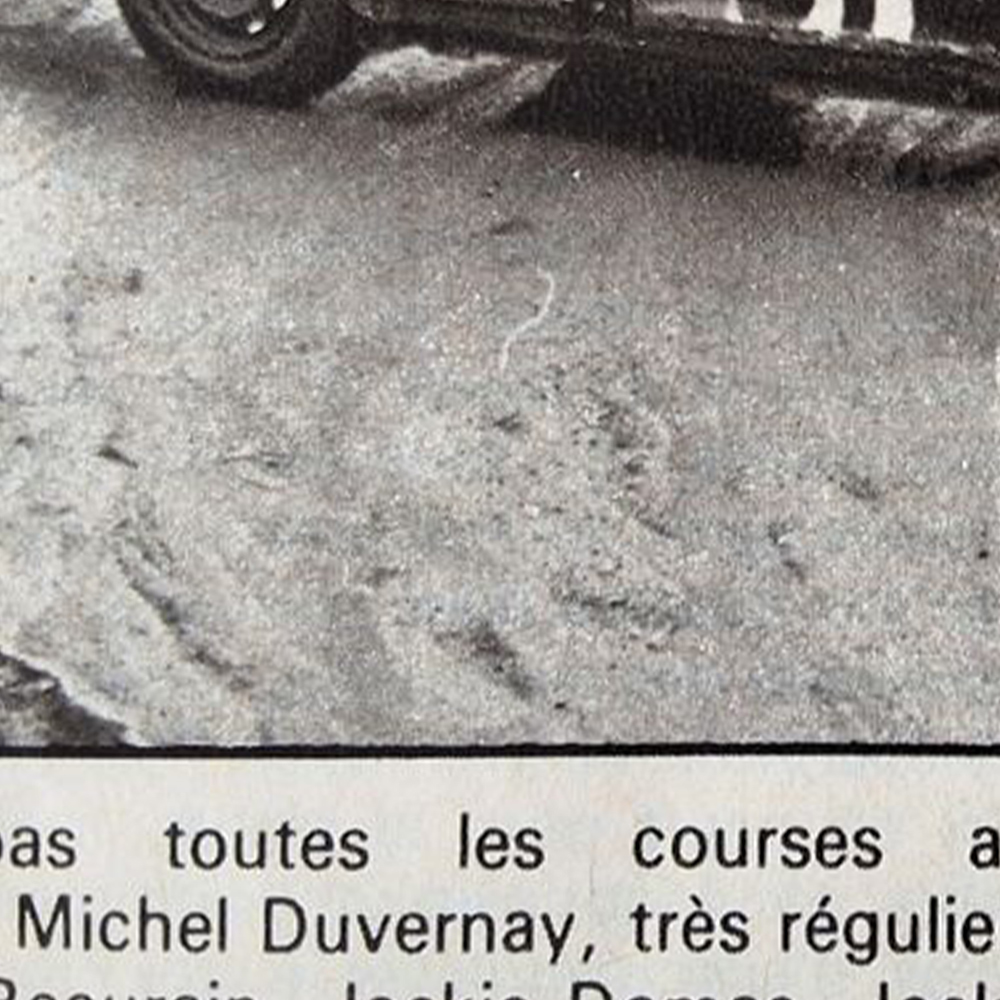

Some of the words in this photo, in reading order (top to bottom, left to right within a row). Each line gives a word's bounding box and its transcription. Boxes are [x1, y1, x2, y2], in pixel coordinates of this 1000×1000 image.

[0, 826, 76, 870] as
[163, 820, 370, 872] toutes
[458, 811, 545, 871] les
[632, 825, 884, 870] courses
[17, 893, 228, 954] Michel
[262, 896, 595, 966] Duvernay,
[628, 893, 751, 955] très
